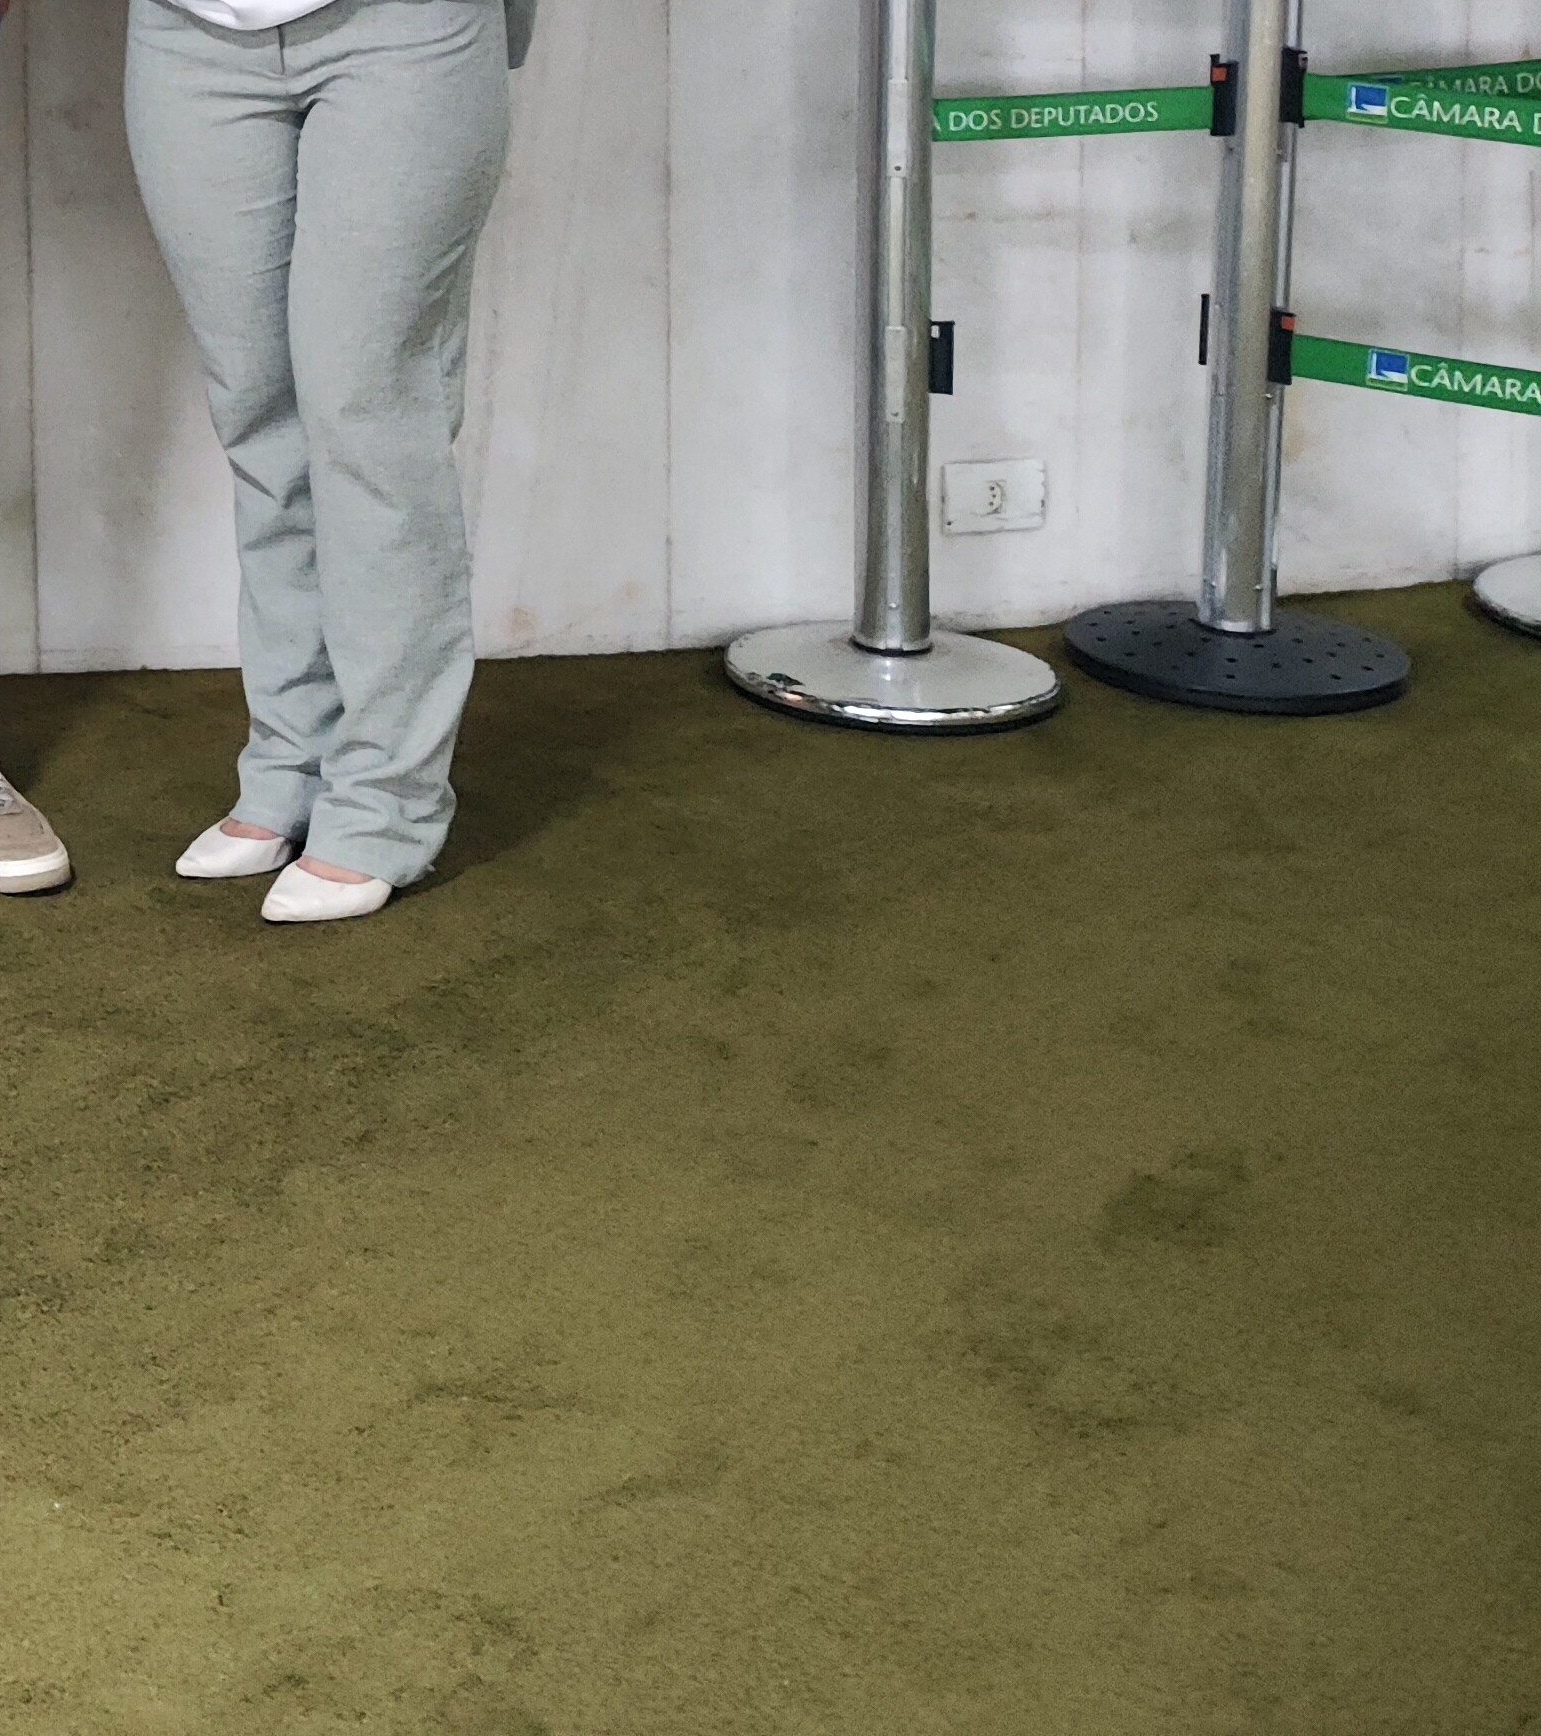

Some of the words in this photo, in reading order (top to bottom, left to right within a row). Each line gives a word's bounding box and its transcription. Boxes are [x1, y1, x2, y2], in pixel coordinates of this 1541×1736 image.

[948, 109, 1002, 132] DOS
[1010, 101, 1159, 129] DEPUTADOS
[1390, 93, 1523, 133] CÂMARA
[1410, 361, 1541, 405] CÂMARA
